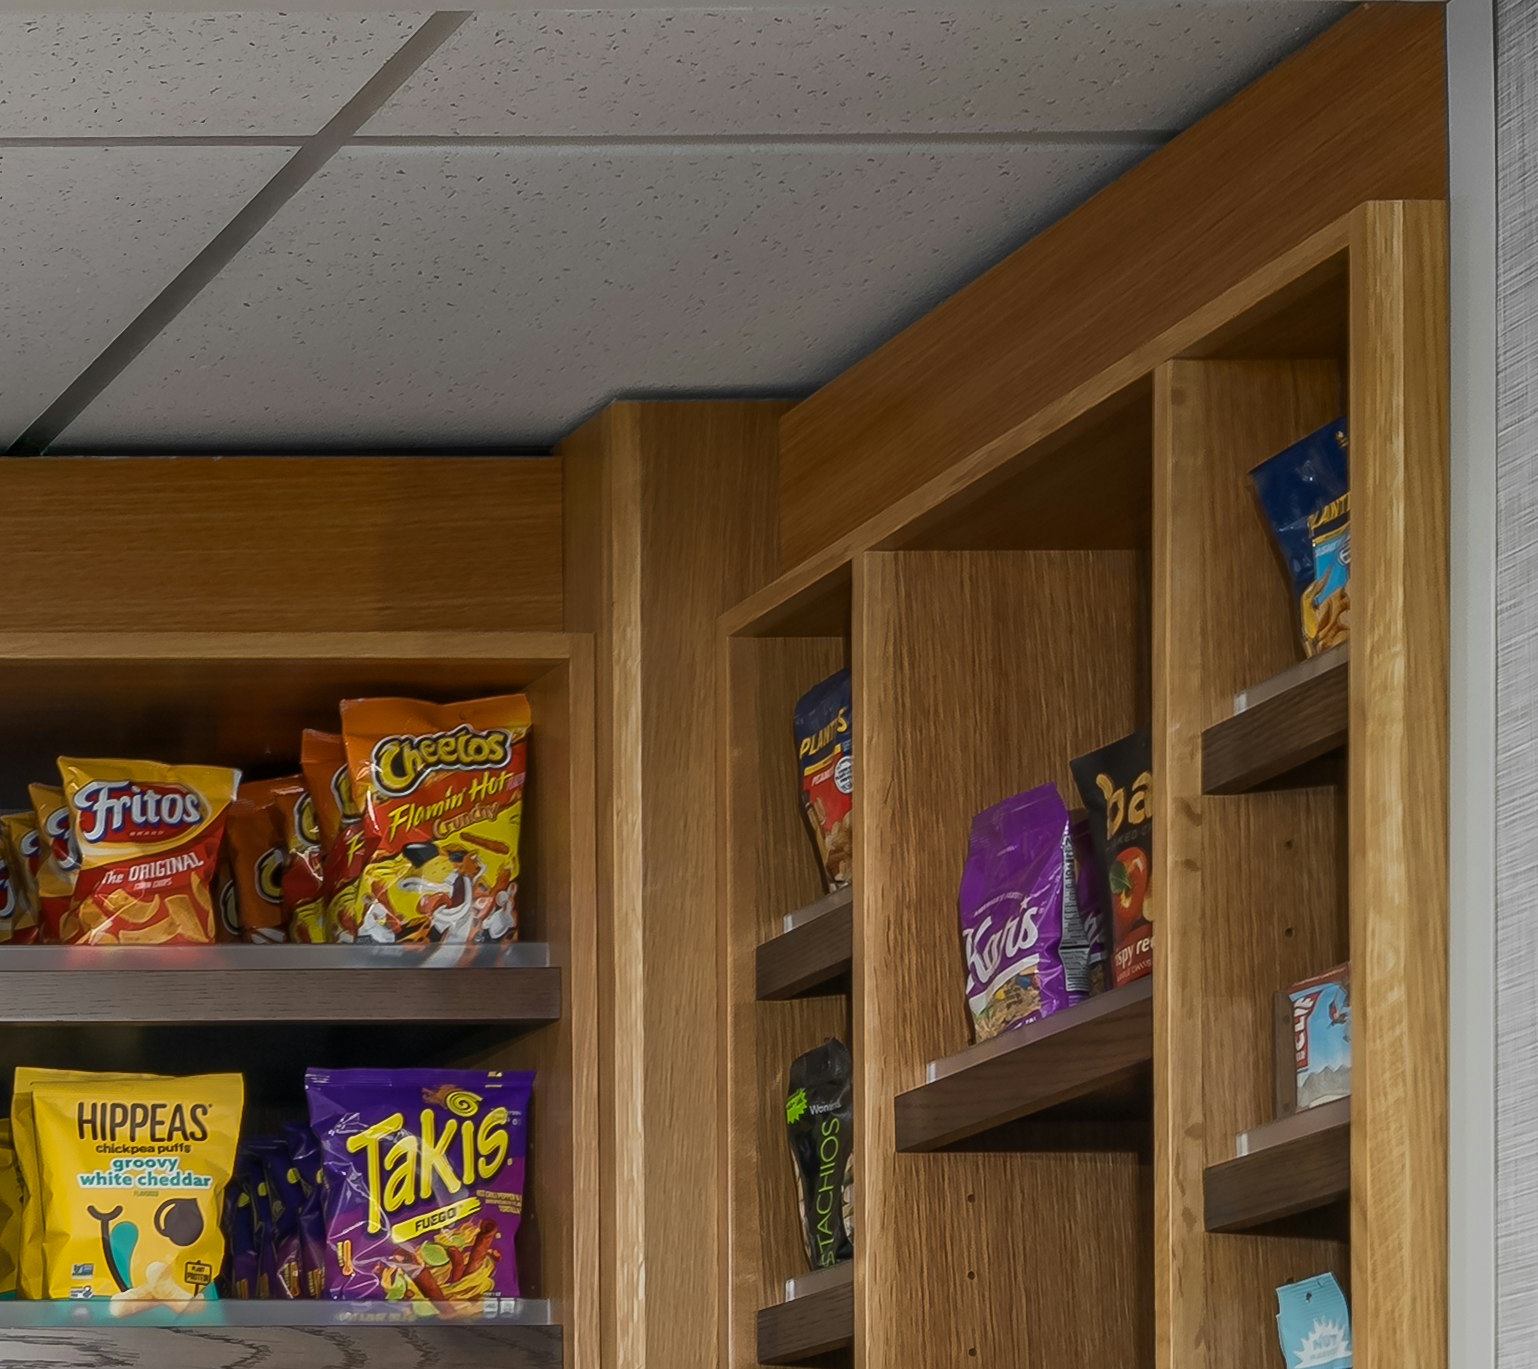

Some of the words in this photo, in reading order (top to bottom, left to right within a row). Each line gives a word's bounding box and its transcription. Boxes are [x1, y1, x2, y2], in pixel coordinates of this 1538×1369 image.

[77, 779, 203, 827] Fritos
[389, 789, 464, 837] Flamin'
[468, 770, 513, 798] Hot
[102, 870, 124, 885] The
[128, 851, 204, 882] ORIGINAL
[965, 903, 1041, 983] Kar's
[78, 1101, 209, 1142] HIPPEAS
[80, 1172, 127, 1187] white
[131, 1172, 211, 1188] cheddar
[112, 1158, 179, 1172] groovy
[347, 1106, 510, 1236] Takis
[414, 1209, 458, 1231] FUEGO
